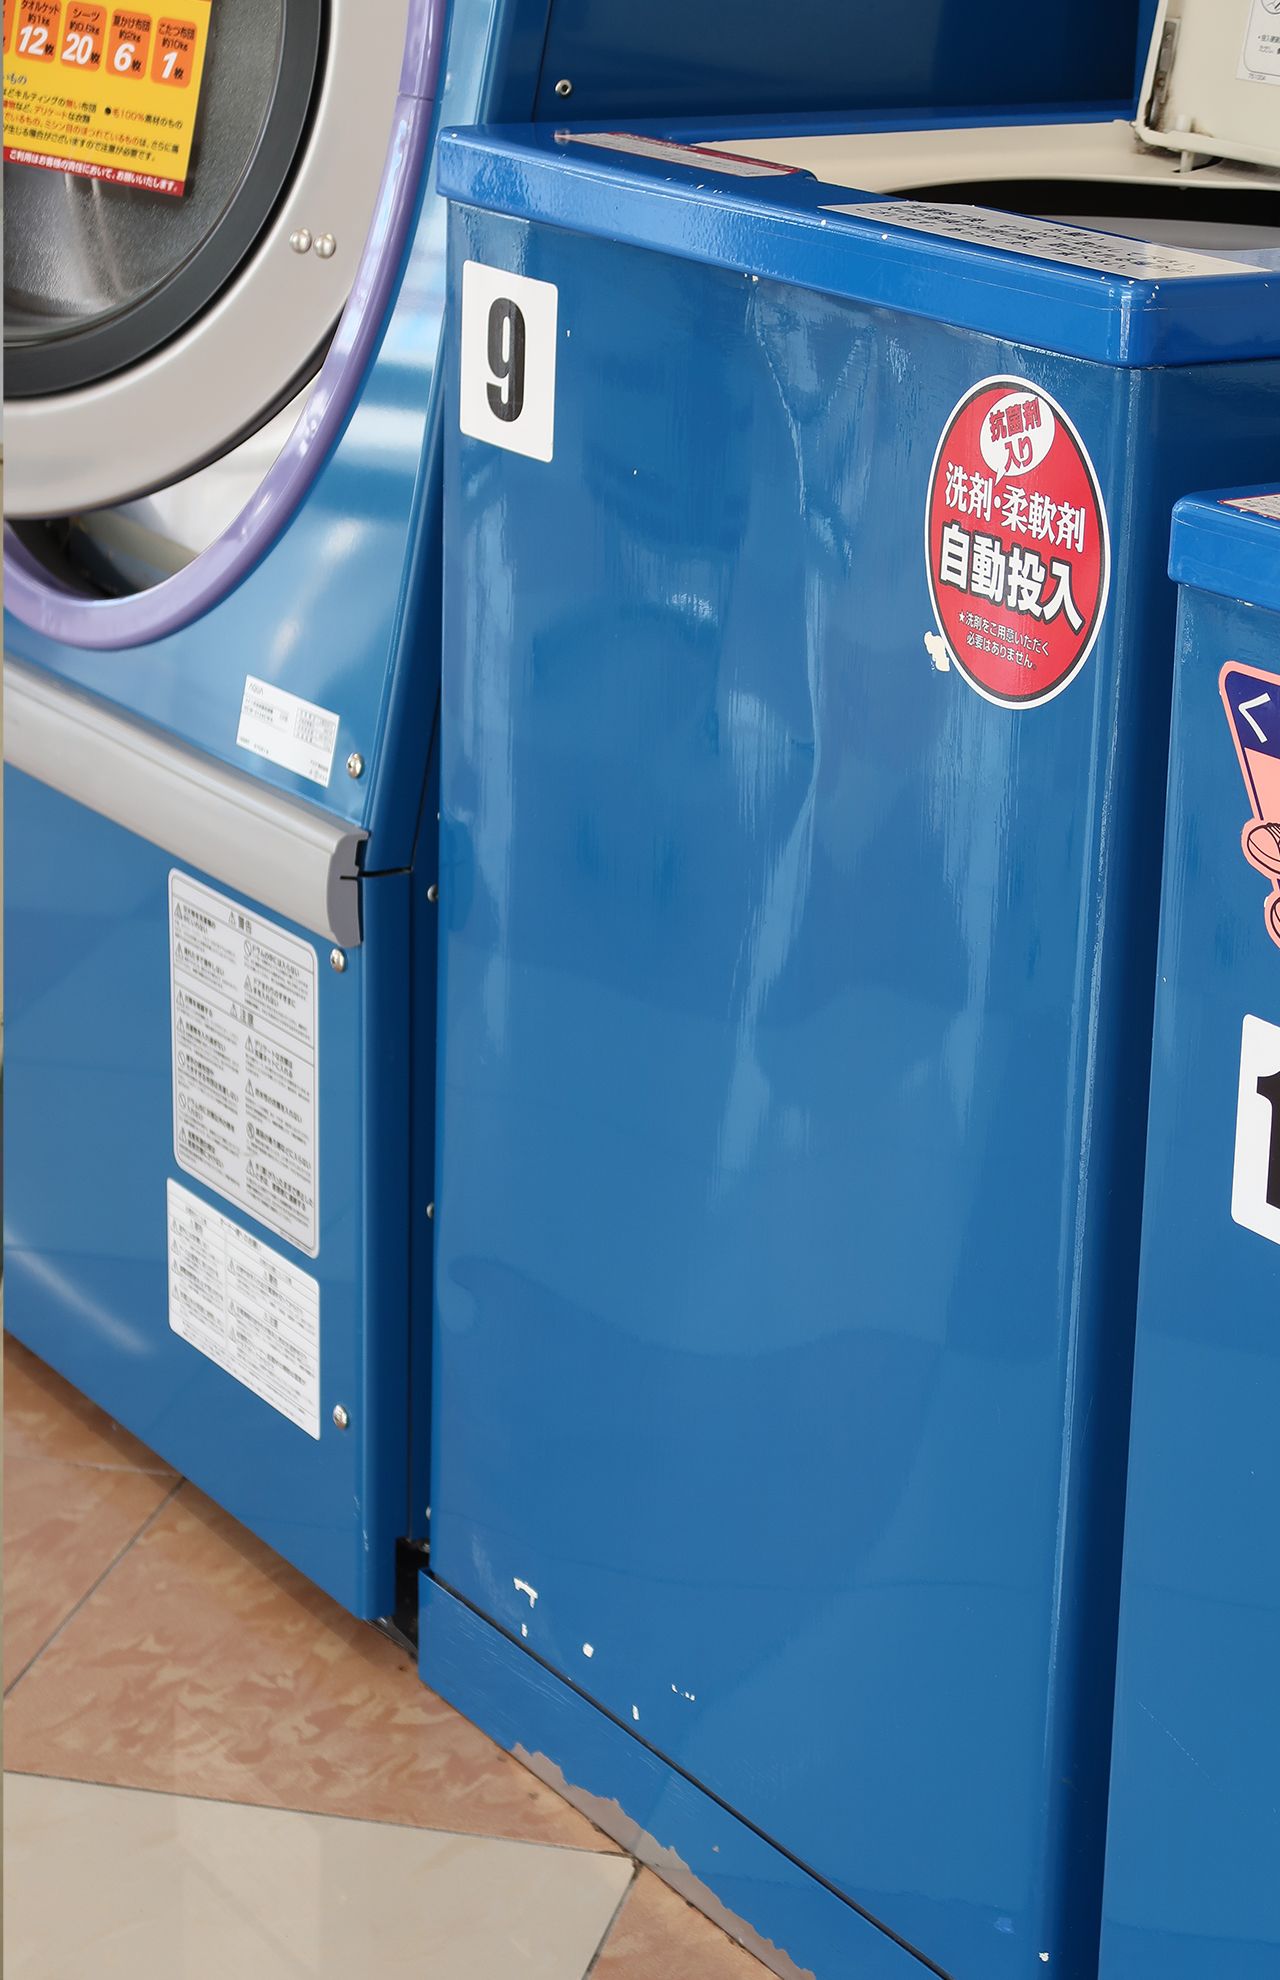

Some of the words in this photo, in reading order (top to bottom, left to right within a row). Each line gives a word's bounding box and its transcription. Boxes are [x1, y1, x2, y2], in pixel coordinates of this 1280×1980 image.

[73, 8, 100, 22] シーツ
[159, 23, 195, 40] こたつ布団
[486, 297, 526, 422] 9
[989, 397, 1041, 442] 抗菌剤
[1005, 436, 1033, 472] 入り
[945, 461, 1086, 553] 洗剤・柔軟剤
[940, 523, 1085, 635] 自動投入
